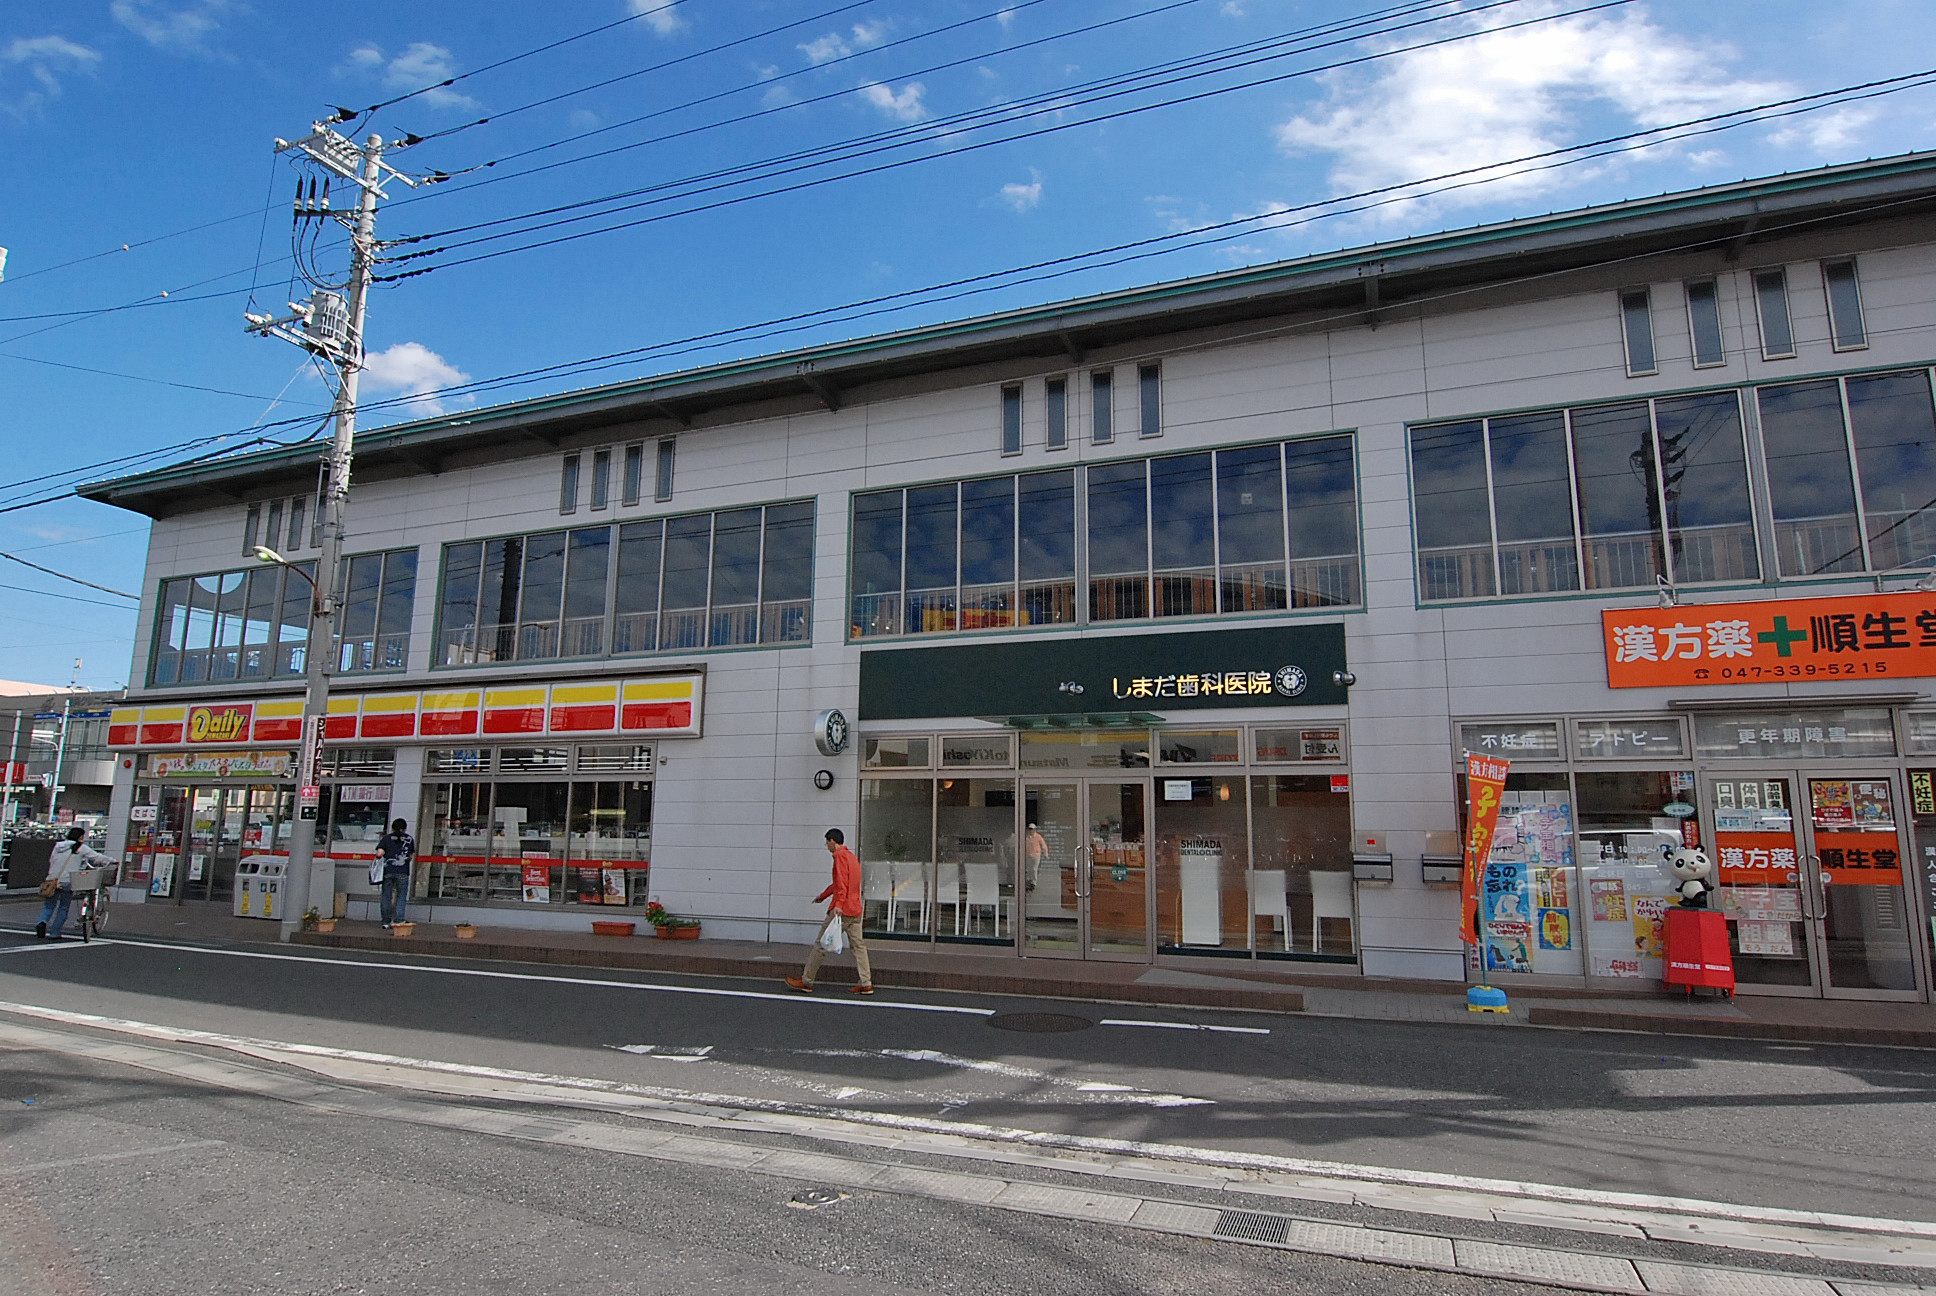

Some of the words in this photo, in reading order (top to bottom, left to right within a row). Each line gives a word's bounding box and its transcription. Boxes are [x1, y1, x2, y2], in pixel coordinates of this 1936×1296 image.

[1613, 620, 1753, 663] 漢方薬
[1721, 661, 1888, 679] 047-339-5215
[1113, 670, 1272, 699] しまだ歯科医院
[192, 707, 248, 741] Daily
[1481, 734, 1538, 749] 不妊症
[1590, 731, 1669, 747] アトピー
[1738, 727, 1847, 744] 更年期障害
[1719, 784, 1735, 808] 口臭
[1742, 784, 1758, 808] 体臭
[1914, 773, 1933, 813] 不妊症
[134, 809, 156, 818] たばこ
[1180, 840, 1222, 848] SHIMADA
[1720, 847, 1796, 869] 漢方薬
[1820, 848, 1898, 869] 順生堂
[1487, 864, 1517, 879] もの
[1741, 924, 1789, 943] 相談
